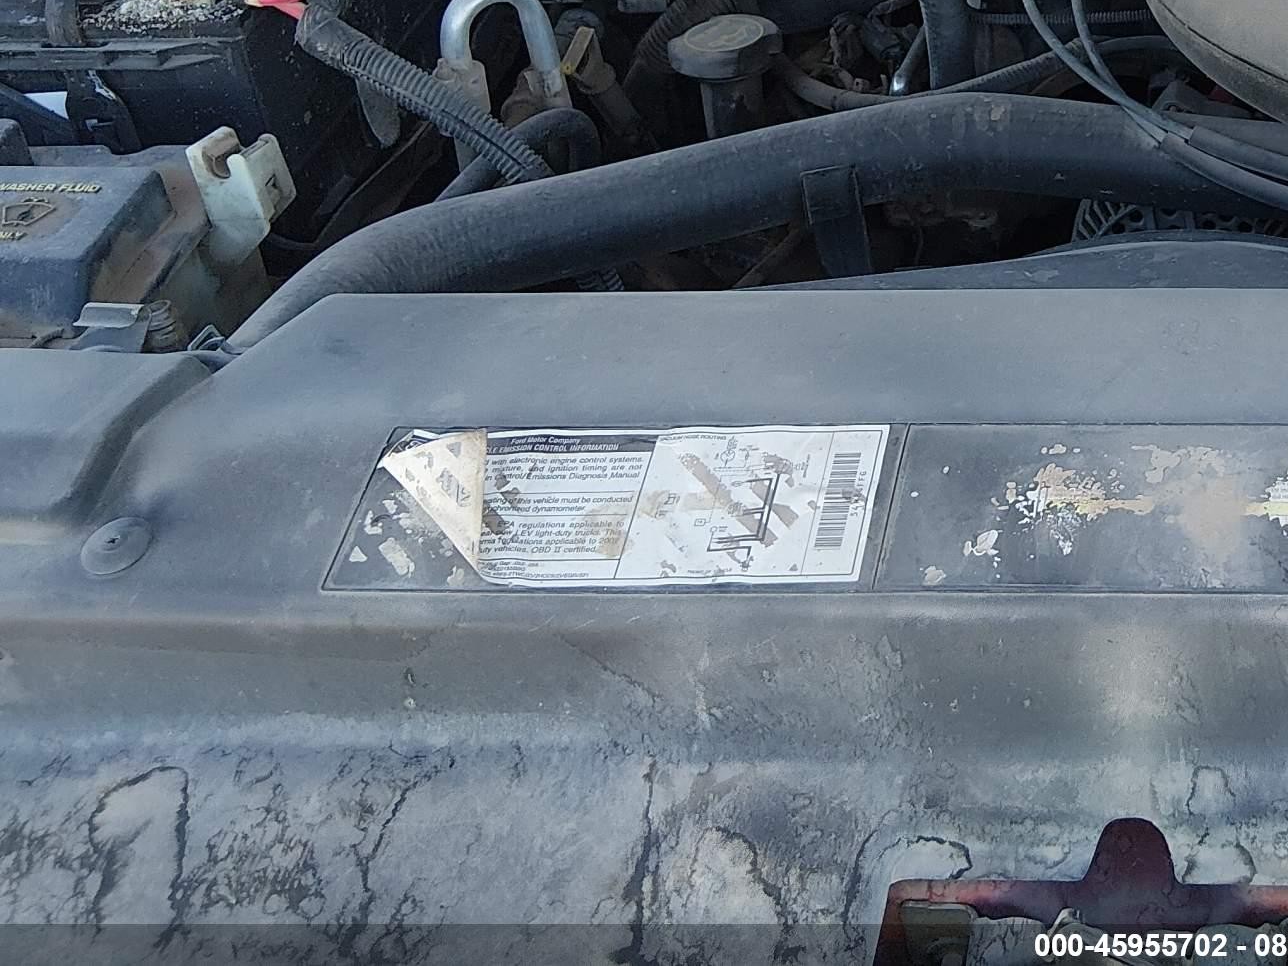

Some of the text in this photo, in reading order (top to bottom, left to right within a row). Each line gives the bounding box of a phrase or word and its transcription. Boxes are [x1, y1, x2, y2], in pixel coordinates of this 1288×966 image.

[57, 183, 100, 193] FLUID
[511, 437, 526, 445] Ford
[548, 436, 581, 445] Company
[499, 444, 532, 453] EMISSION
[533, 444, 567, 452] CONTROL
[570, 443, 619, 452] INFORMATION
[491, 458, 508, 466] with
[509, 456, 547, 465] electronic
[550, 457, 577, 466] engine
[579, 456, 607, 464] control
[547, 464, 578, 474] ignition
[582, 464, 608, 473] timing
[569, 472, 607, 481] Diagnosis
[609, 471, 641, 480] Manual
[517, 496, 531, 505] this
[534, 495, 559, 504] vehicle
[561, 496, 580, 504] must
[581, 495, 591, 504] be
[592, 494, 634, 504] conducted
[519, 520, 566, 530] regulations
[569, 519, 612, 529] applicable
[535, 529, 572, 539] light-duty
[545, 536, 586, 546] applicable
[588, 537, 597, 545] to
[531, 546, 552, 554] OBD
